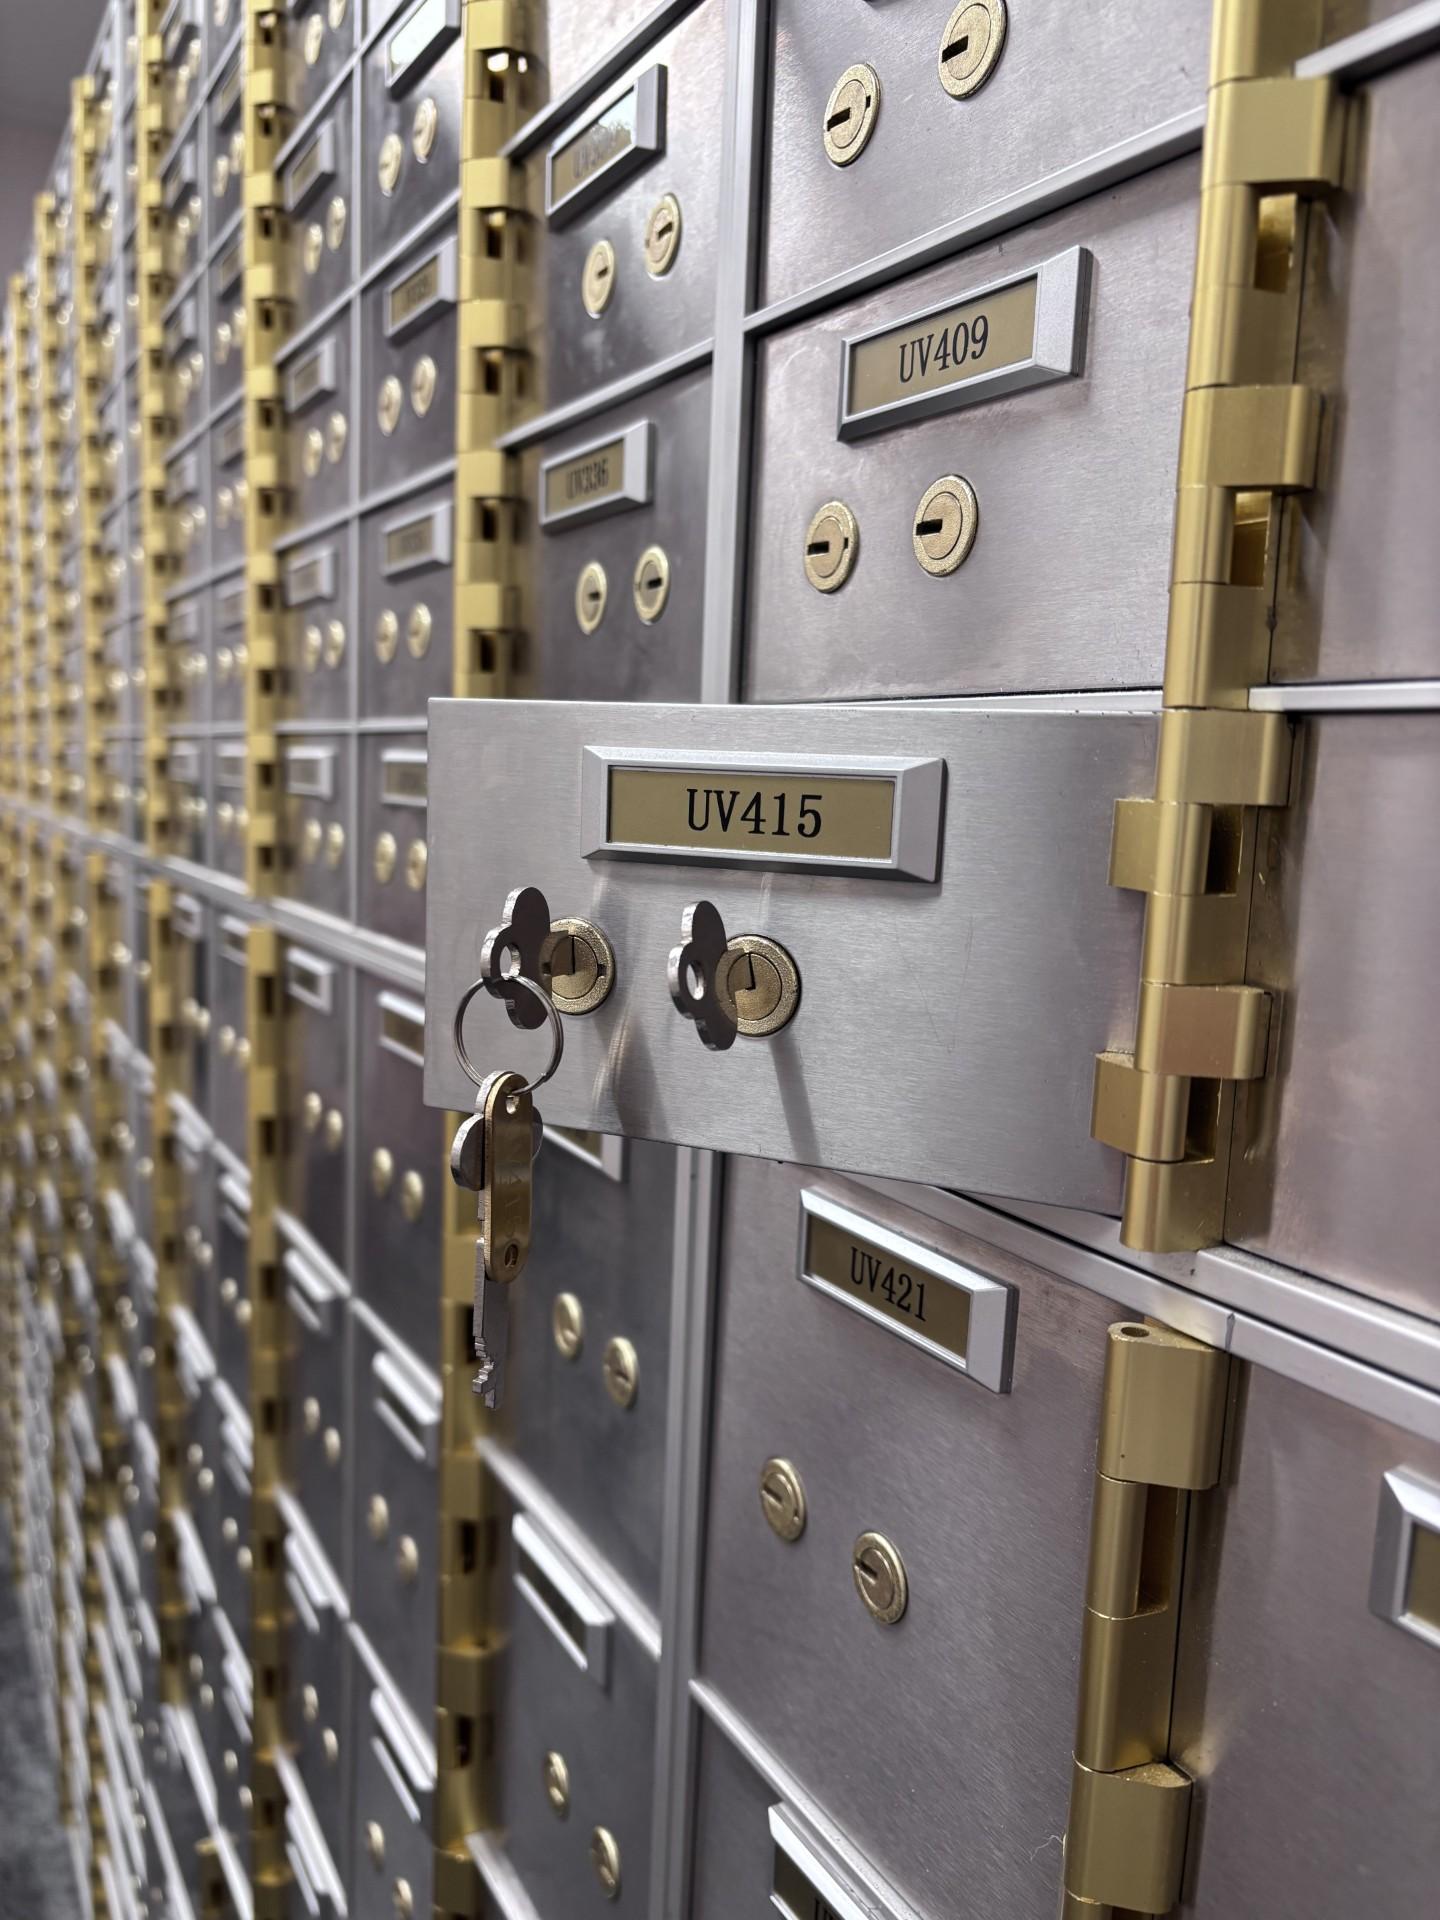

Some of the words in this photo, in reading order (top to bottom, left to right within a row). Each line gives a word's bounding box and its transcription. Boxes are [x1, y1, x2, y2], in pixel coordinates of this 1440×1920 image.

[899, 315, 989, 383] UV409
[686, 788, 823, 838] UV415
[851, 1246, 927, 1322] UV421
